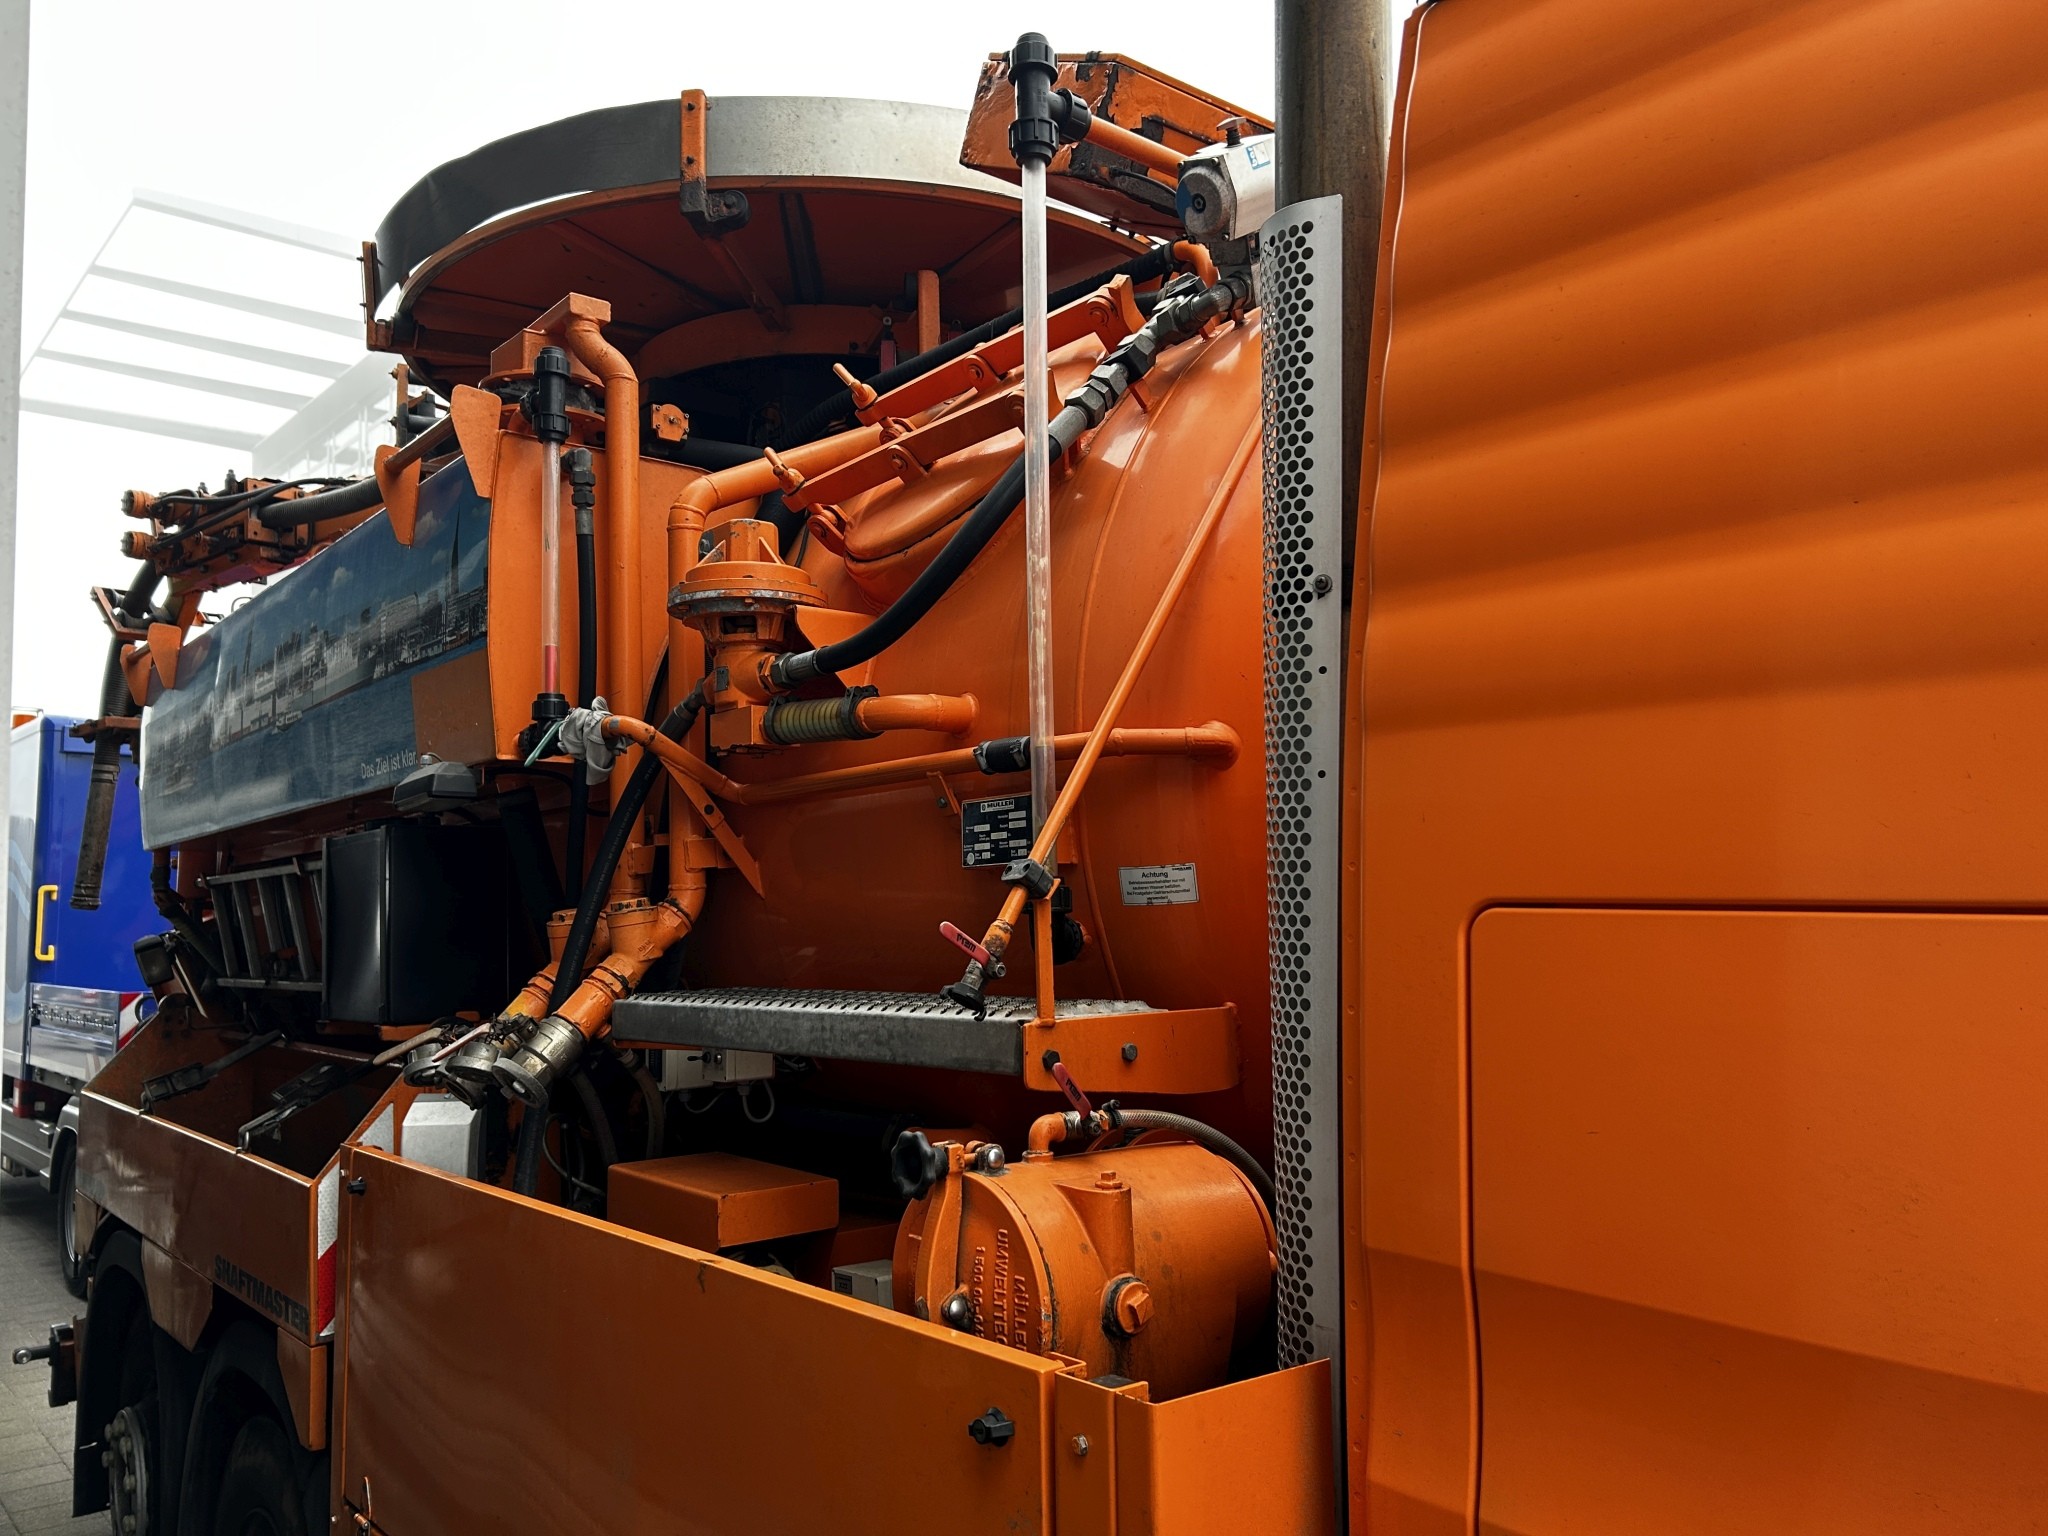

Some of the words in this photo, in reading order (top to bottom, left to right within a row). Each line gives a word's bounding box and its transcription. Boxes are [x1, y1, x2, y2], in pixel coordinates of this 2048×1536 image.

[360, 762, 375, 780] Das
[375, 754, 390, 776] Ziel
[390, 752, 401, 772] ist
[401, 748, 418, 768] klar.
[1141, 871, 1169, 879] Achtung
[214, 1253, 309, 1334] SHAFTMASTER
